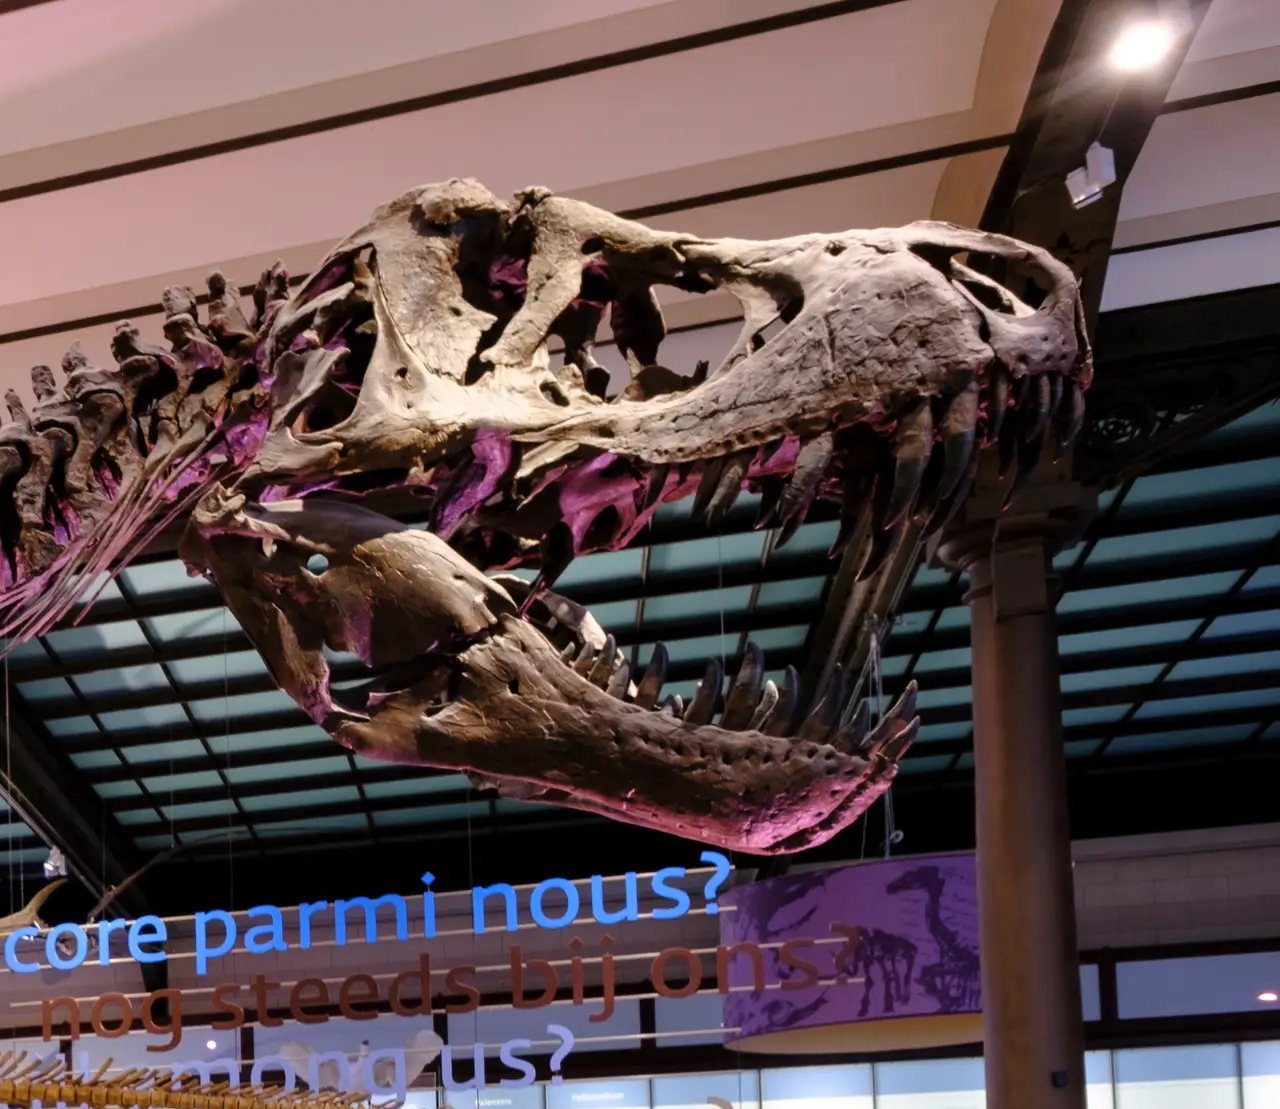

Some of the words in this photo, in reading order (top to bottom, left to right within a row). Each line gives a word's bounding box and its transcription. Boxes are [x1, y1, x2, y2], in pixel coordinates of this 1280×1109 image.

[195, 871, 436, 975] parmi
[472, 851, 731, 934] nous?
[42, 988, 182, 1052] nog
[211, 953, 481, 1028] steeds
[512, 934, 616, 1022] bij
[651, 921, 862, 998] ons?
[127, 1046, 406, 1102] mong
[441, 1024, 575, 1092] us?
